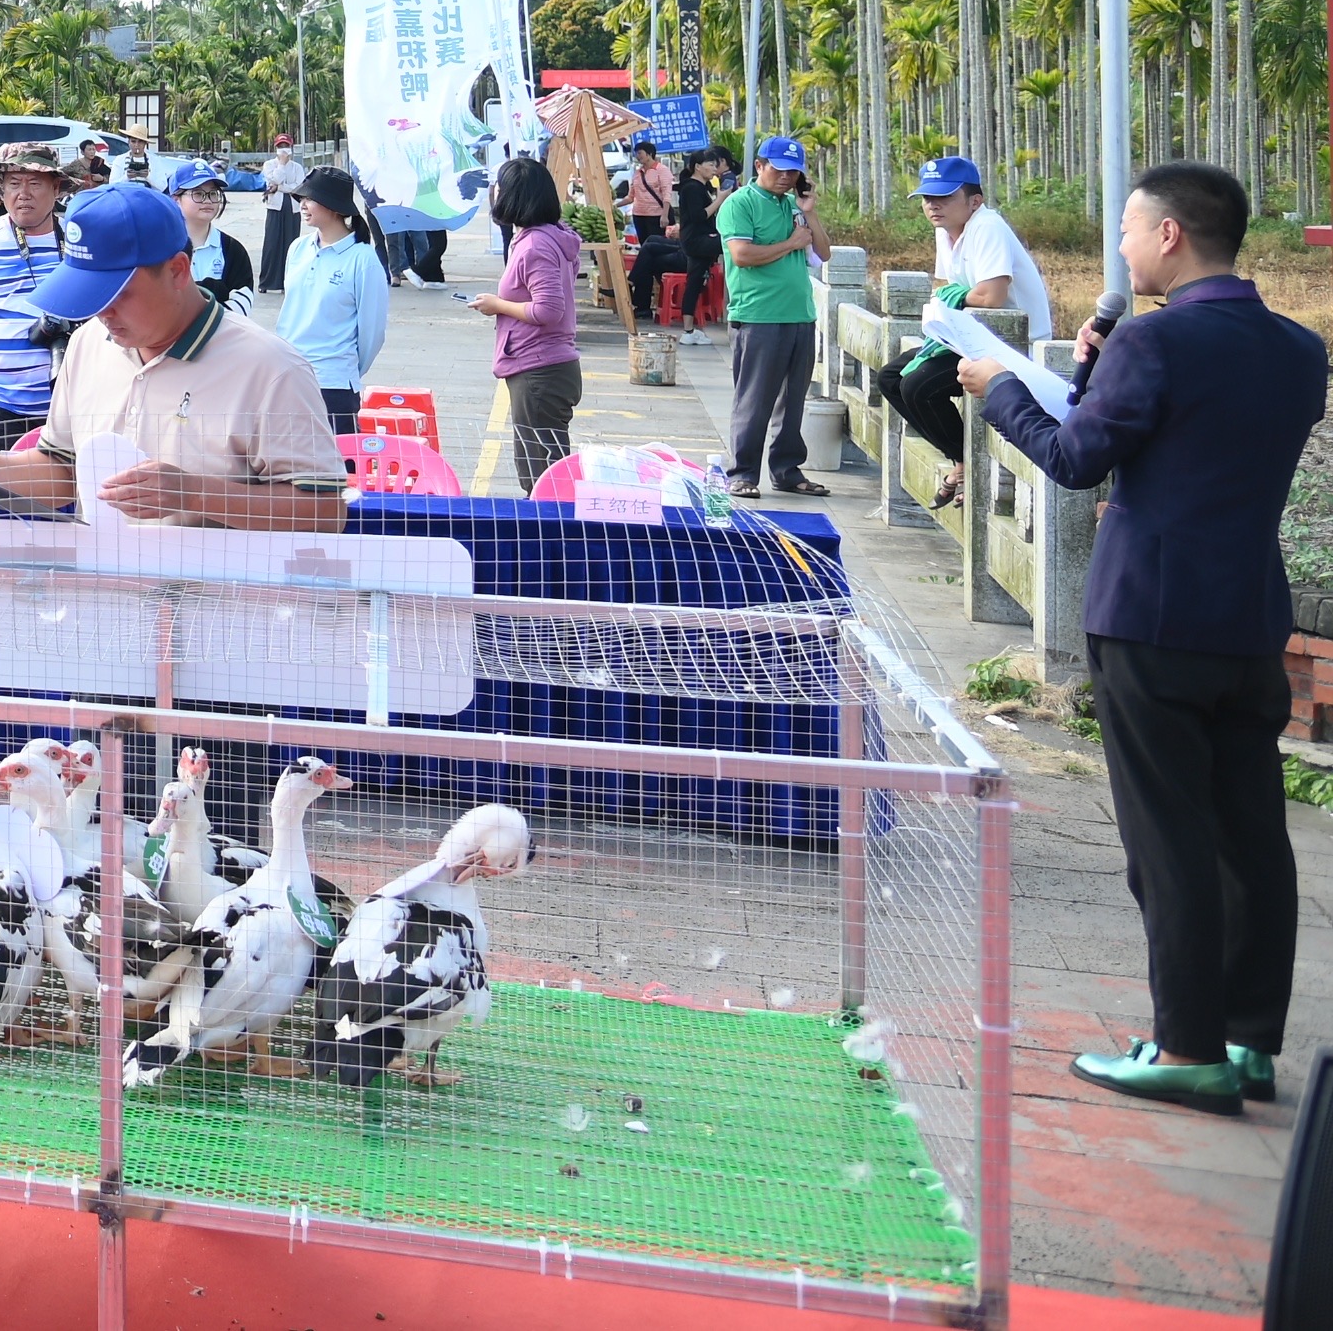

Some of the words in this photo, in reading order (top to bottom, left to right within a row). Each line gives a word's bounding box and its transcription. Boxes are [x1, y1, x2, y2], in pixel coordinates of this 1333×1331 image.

[585, 497, 651, 515] 王绍任
[300, 910, 333, 941] 母鸭
